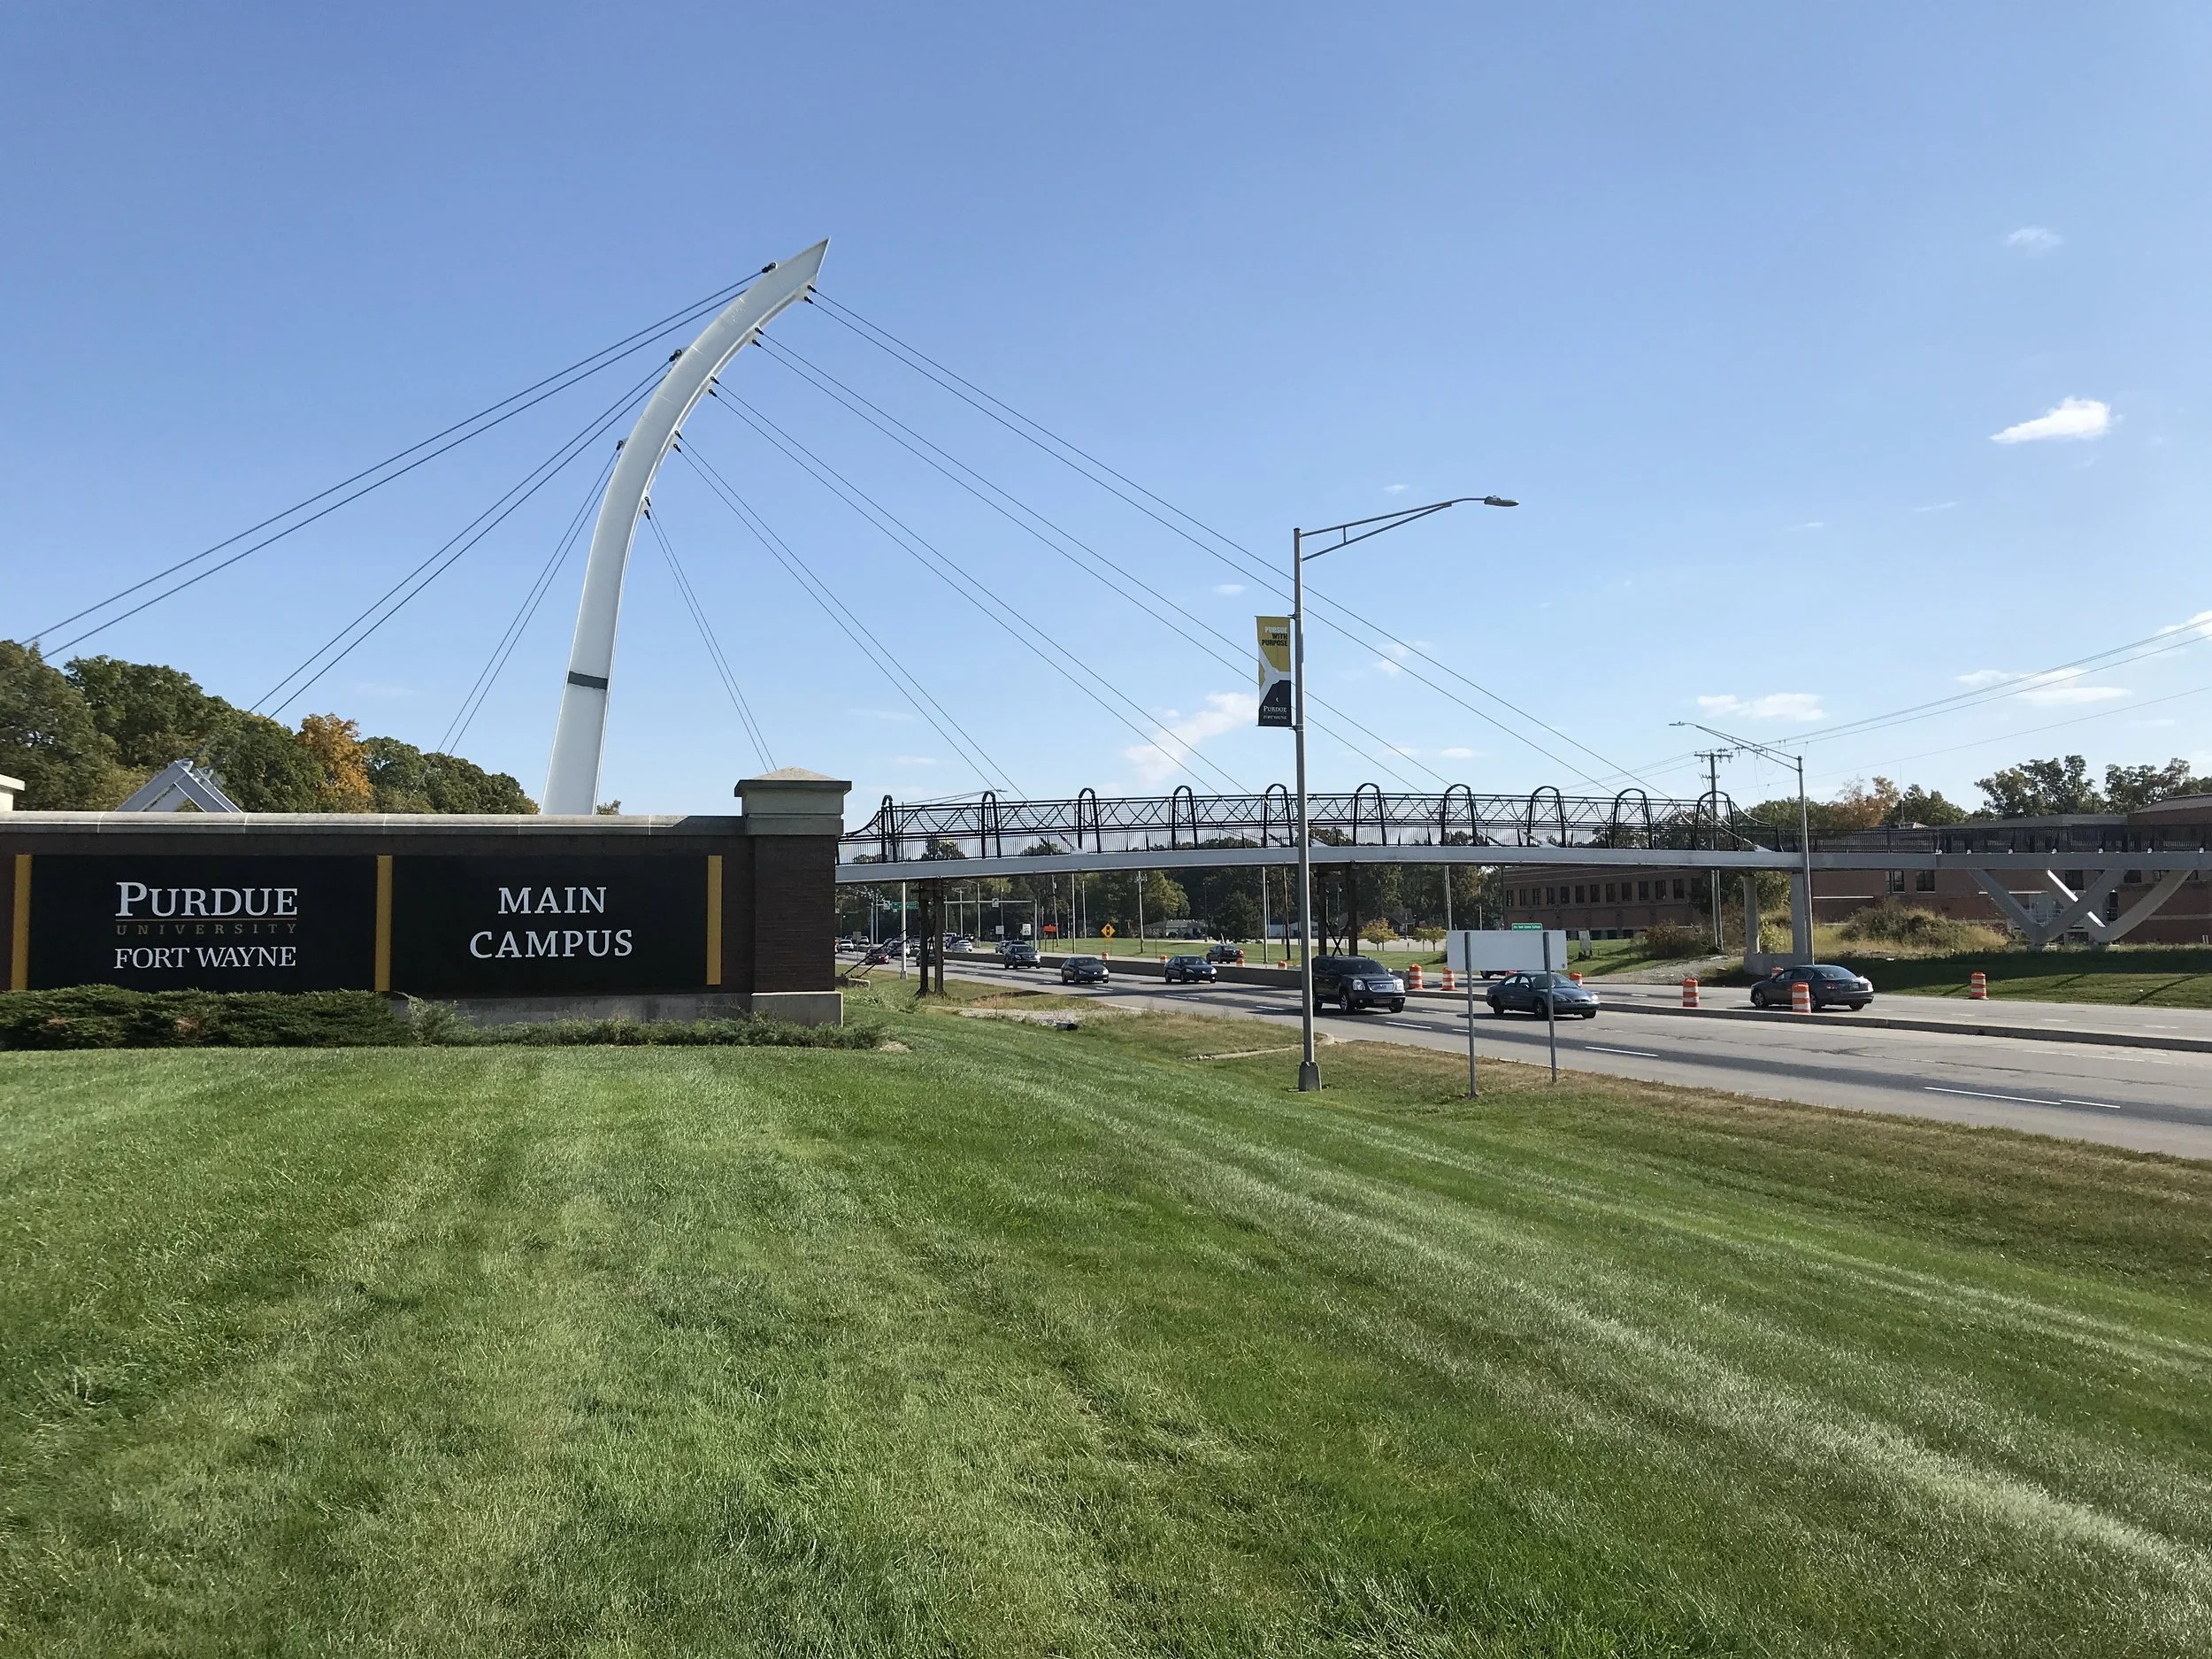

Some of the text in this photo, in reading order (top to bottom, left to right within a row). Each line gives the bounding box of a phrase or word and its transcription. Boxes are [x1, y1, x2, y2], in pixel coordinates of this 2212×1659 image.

[115, 881, 298, 917] PURDUE
[497, 887, 607, 915] MAIN
[116, 924, 296, 935] UNIVERSITY
[113, 946, 296, 969] FORT WAYNE
[470, 929, 633, 959] CAMPUS
